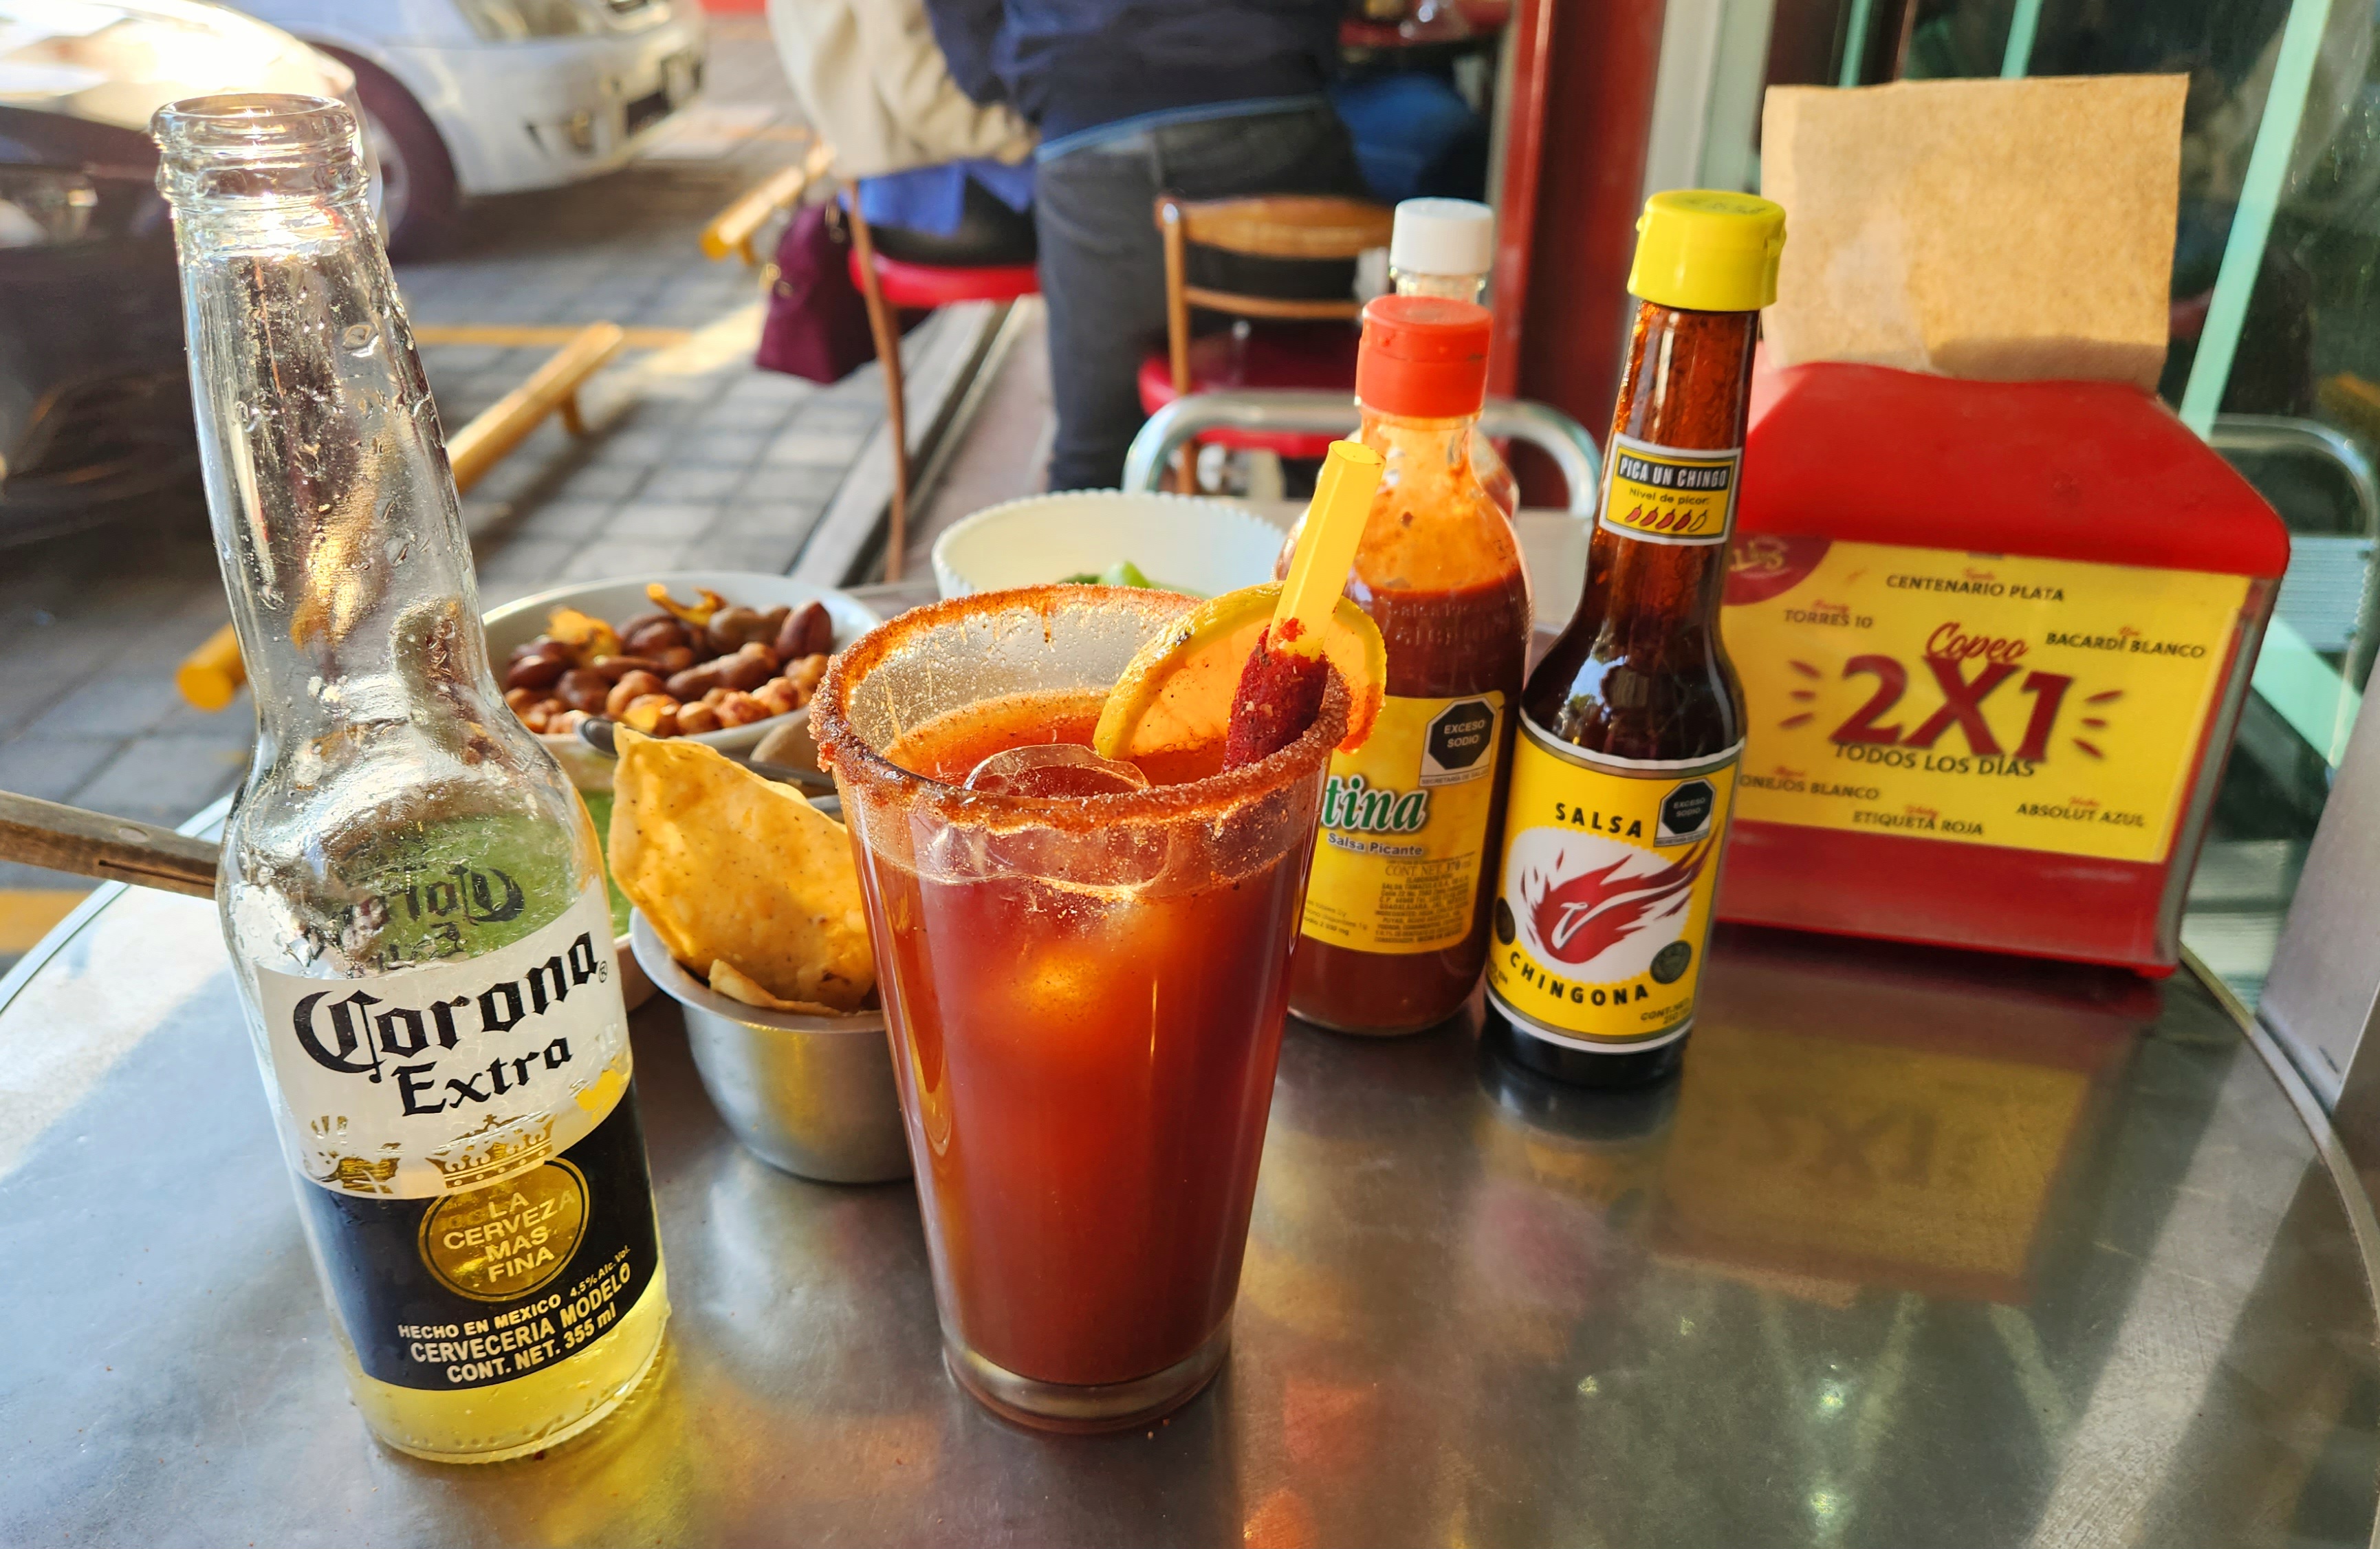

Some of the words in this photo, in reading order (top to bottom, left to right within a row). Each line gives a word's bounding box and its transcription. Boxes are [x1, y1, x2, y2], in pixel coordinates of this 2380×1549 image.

[1619, 457, 1648, 481] PICA
[1652, 466, 1674, 485] UN
[1677, 469, 1727, 487] CHINGO
[1629, 487, 1655, 500] Nivel
[1659, 493, 1674, 503] de
[1886, 574, 2005, 597] CENTENARIO
[2009, 583, 2064, 601] PLATA
[1784, 609, 1850, 628] TORRES
[1855, 616, 1873, 629] 10
[1925, 621, 2029, 662] Copeo
[2129, 640, 2207, 659] BLANCO
[1828, 653, 2075, 763] 2X1
[1444, 719, 1485, 735] EXCESO
[1447, 734, 1480, 748] SODIO
[1835, 742, 1917, 769] TODOS
[1925, 754, 1970, 775] LOS
[1323, 776, 1426, 831] tina
[1673, 797, 1706, 809] EXCESO
[1739, 774, 1805, 792] ONEJOS
[1810, 781, 1881, 801] BLANCO
[1555, 802, 1641, 838] SALSA
[1853, 810, 1936, 830] ETIQUETA
[1941, 819, 1985, 836] ROJA
[2016, 803, 2096, 821] ABSOLUT
[2099, 811, 2145, 827] AZUL
[1329, 832, 1366, 852] Salsa
[1369, 841, 1423, 856] Picante
[1510, 951, 1648, 1006] CHINGONA
[294, 931, 599, 1083] Corona
[391, 1037, 573, 1117] Extra
[443, 1190, 576, 1250] CERVEZA
[489, 1191, 529, 1219] LA
[485, 1226, 549, 1263] MAS
[488, 1246, 555, 1283] FINA
[397, 1323, 459, 1340] HECHO
[463, 1319, 490, 1336] EN
[494, 1293, 561, 1329] MEXICO
[411, 1316, 556, 1363] CERVECERIA
[560, 1261, 631, 1328] MODELO
[446, 1360, 512, 1383] CONT.
[515, 1339, 561, 1371] NET.
[563, 1317, 596, 1350] 355
[597, 1301, 617, 1330] ml
